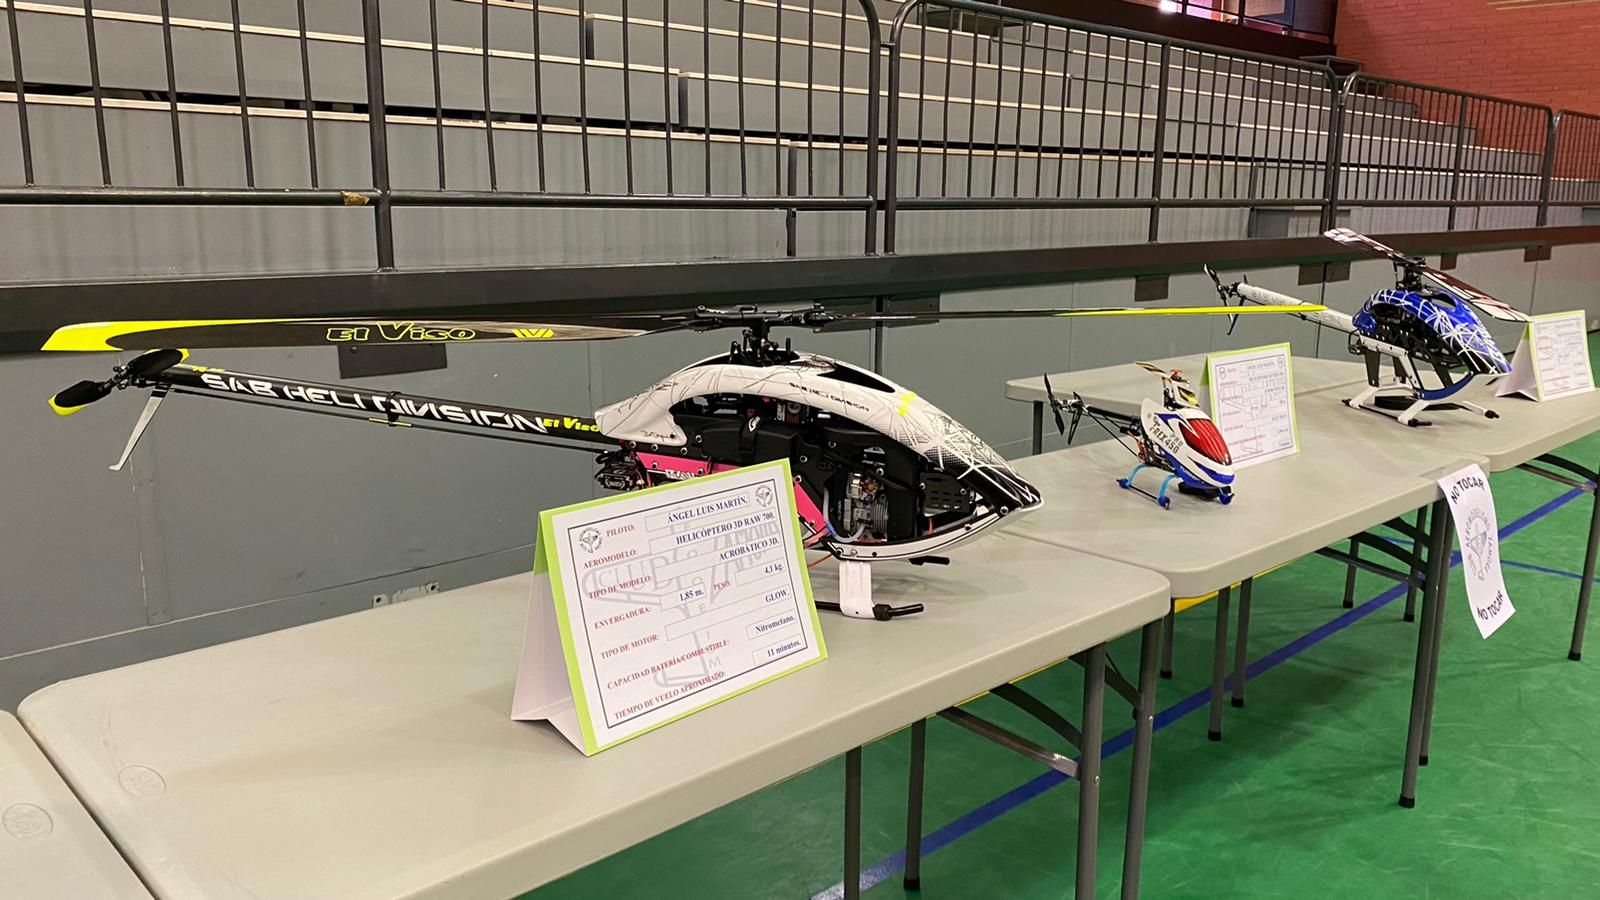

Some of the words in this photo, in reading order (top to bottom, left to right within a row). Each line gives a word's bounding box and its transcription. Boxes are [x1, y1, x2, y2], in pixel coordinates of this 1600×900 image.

[201, 373, 279, 398] SAB
[283, 385, 367, 410] HELI
[371, 395, 549, 434] DIVISION
[667, 508, 696, 524] ÁNGEL
[696, 502, 715, 516] LUIS
[715, 495, 748, 511] MARTÍN.
[1451, 487, 1461, 505] NO
[1456, 475, 1486, 492] TOCAR
[583, 548, 638, 569] AEROMODELO:
[676, 523, 733, 545] HELICÓPTERO
[734, 520, 743, 532] 3D
[744, 514, 762, 527] RAW
[762, 511, 776, 521] 700.
[588, 588, 607, 600] TIPO
[607, 585, 618, 594] DE
[619, 574, 652, 590] MODELO:
[719, 538, 768, 561] ACROBÁTICO
[768, 536, 780, 547] 3D.
[594, 606, 652, 630] ENVERGADURA:
[680, 589, 694, 602] 1,85
[694, 588, 705, 597] m.
[765, 564, 775, 575] 4,1
[774, 562, 785, 573] kg.
[600, 649, 619, 660] TIPO
[619, 644, 631, 653] DE
[631, 634, 660, 649] MOTOR:
[765, 588, 790, 603] GLOW.
[1476, 605, 1489, 621] NO
[1487, 589, 1504, 620] TOCAR
[607, 668, 651, 690] CAPACIDAD
[755, 614, 796, 634] Nitrometano.
[614, 702, 644, 720] TIEMPO
[644, 698, 654, 707] DE
[655, 688, 680, 704] VUELO
[680, 671, 726, 695] APROXIMADO:
[767, 647, 775, 658] 11
[775, 639, 802, 654] minutos.
